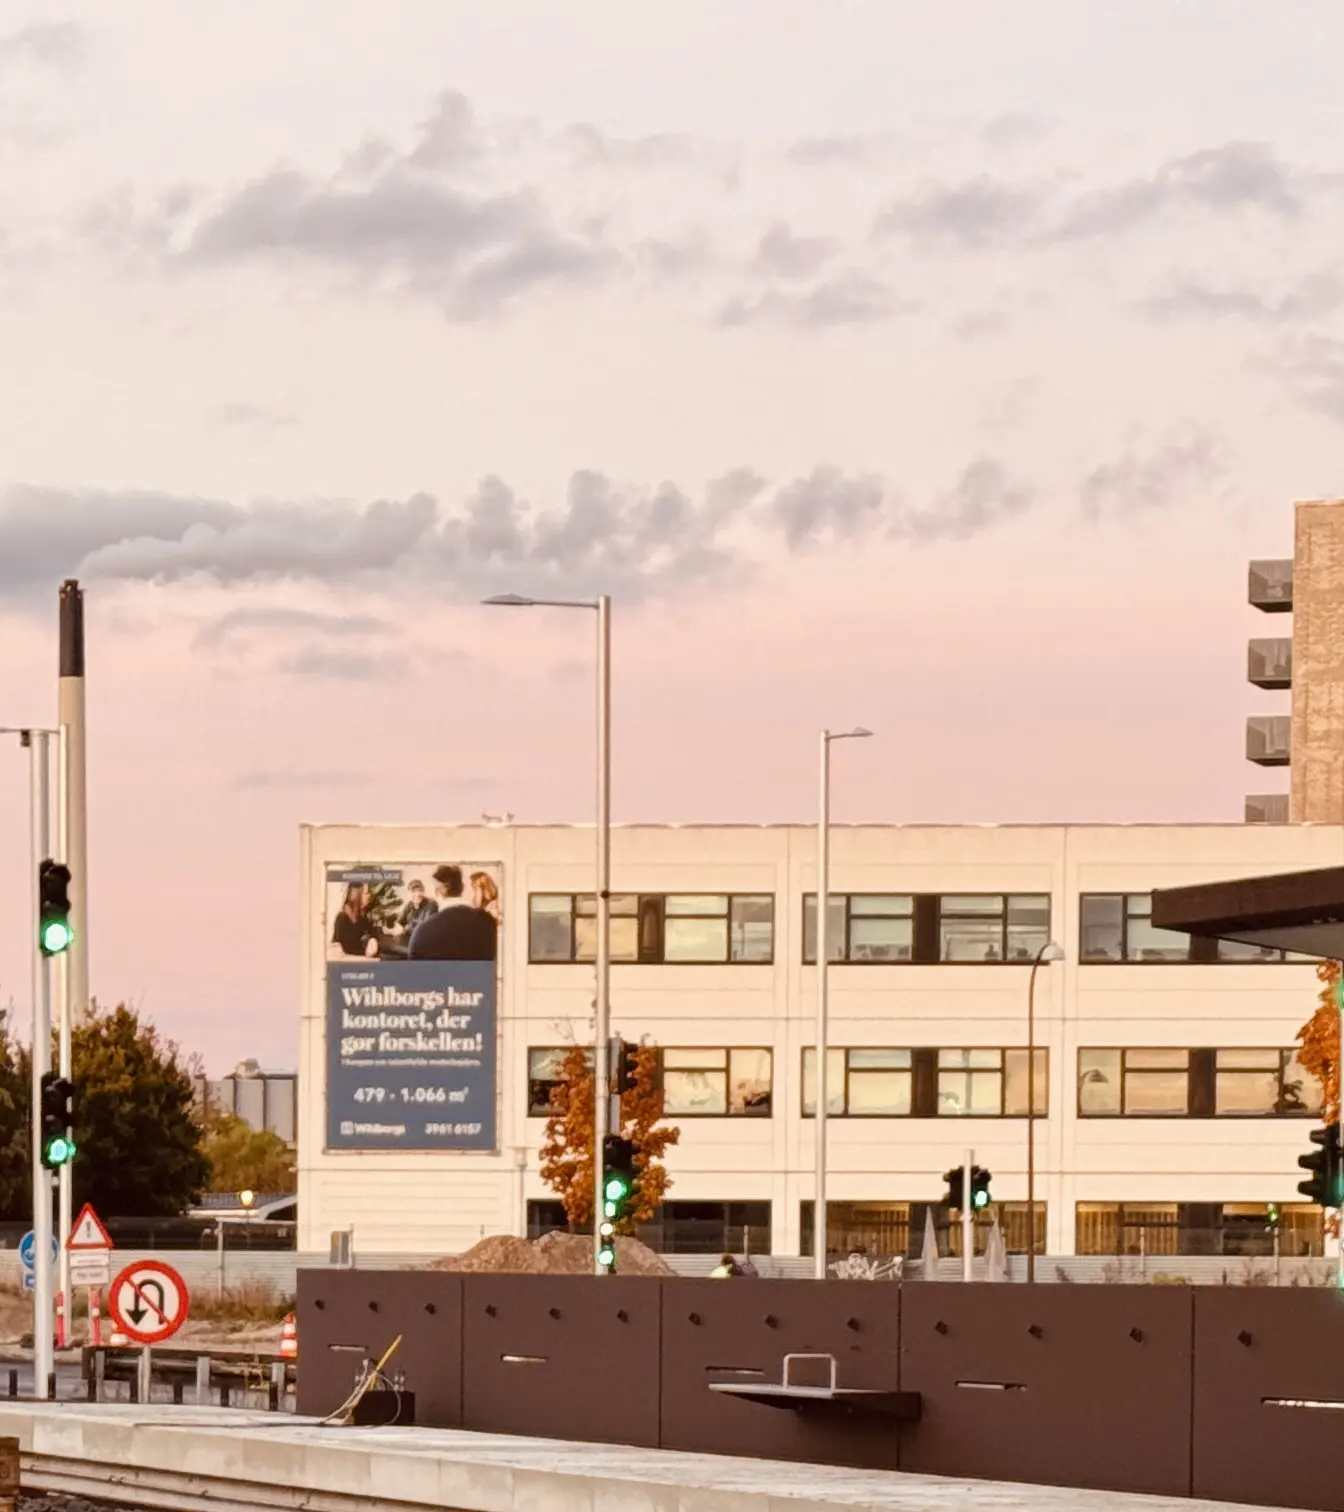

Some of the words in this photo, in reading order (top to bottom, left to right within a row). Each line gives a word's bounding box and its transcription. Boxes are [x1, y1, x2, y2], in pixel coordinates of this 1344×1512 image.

[342, 986, 445, 1011] Wihlborgs
[447, 986, 484, 1006] har
[341, 1008, 434, 1031] kontoret,
[436, 1008, 472, 1029] der
[378, 1031, 484, 1052] forskellen!
[353, 1086, 386, 1103] 479
[400, 1086, 446, 1103] 1.066
